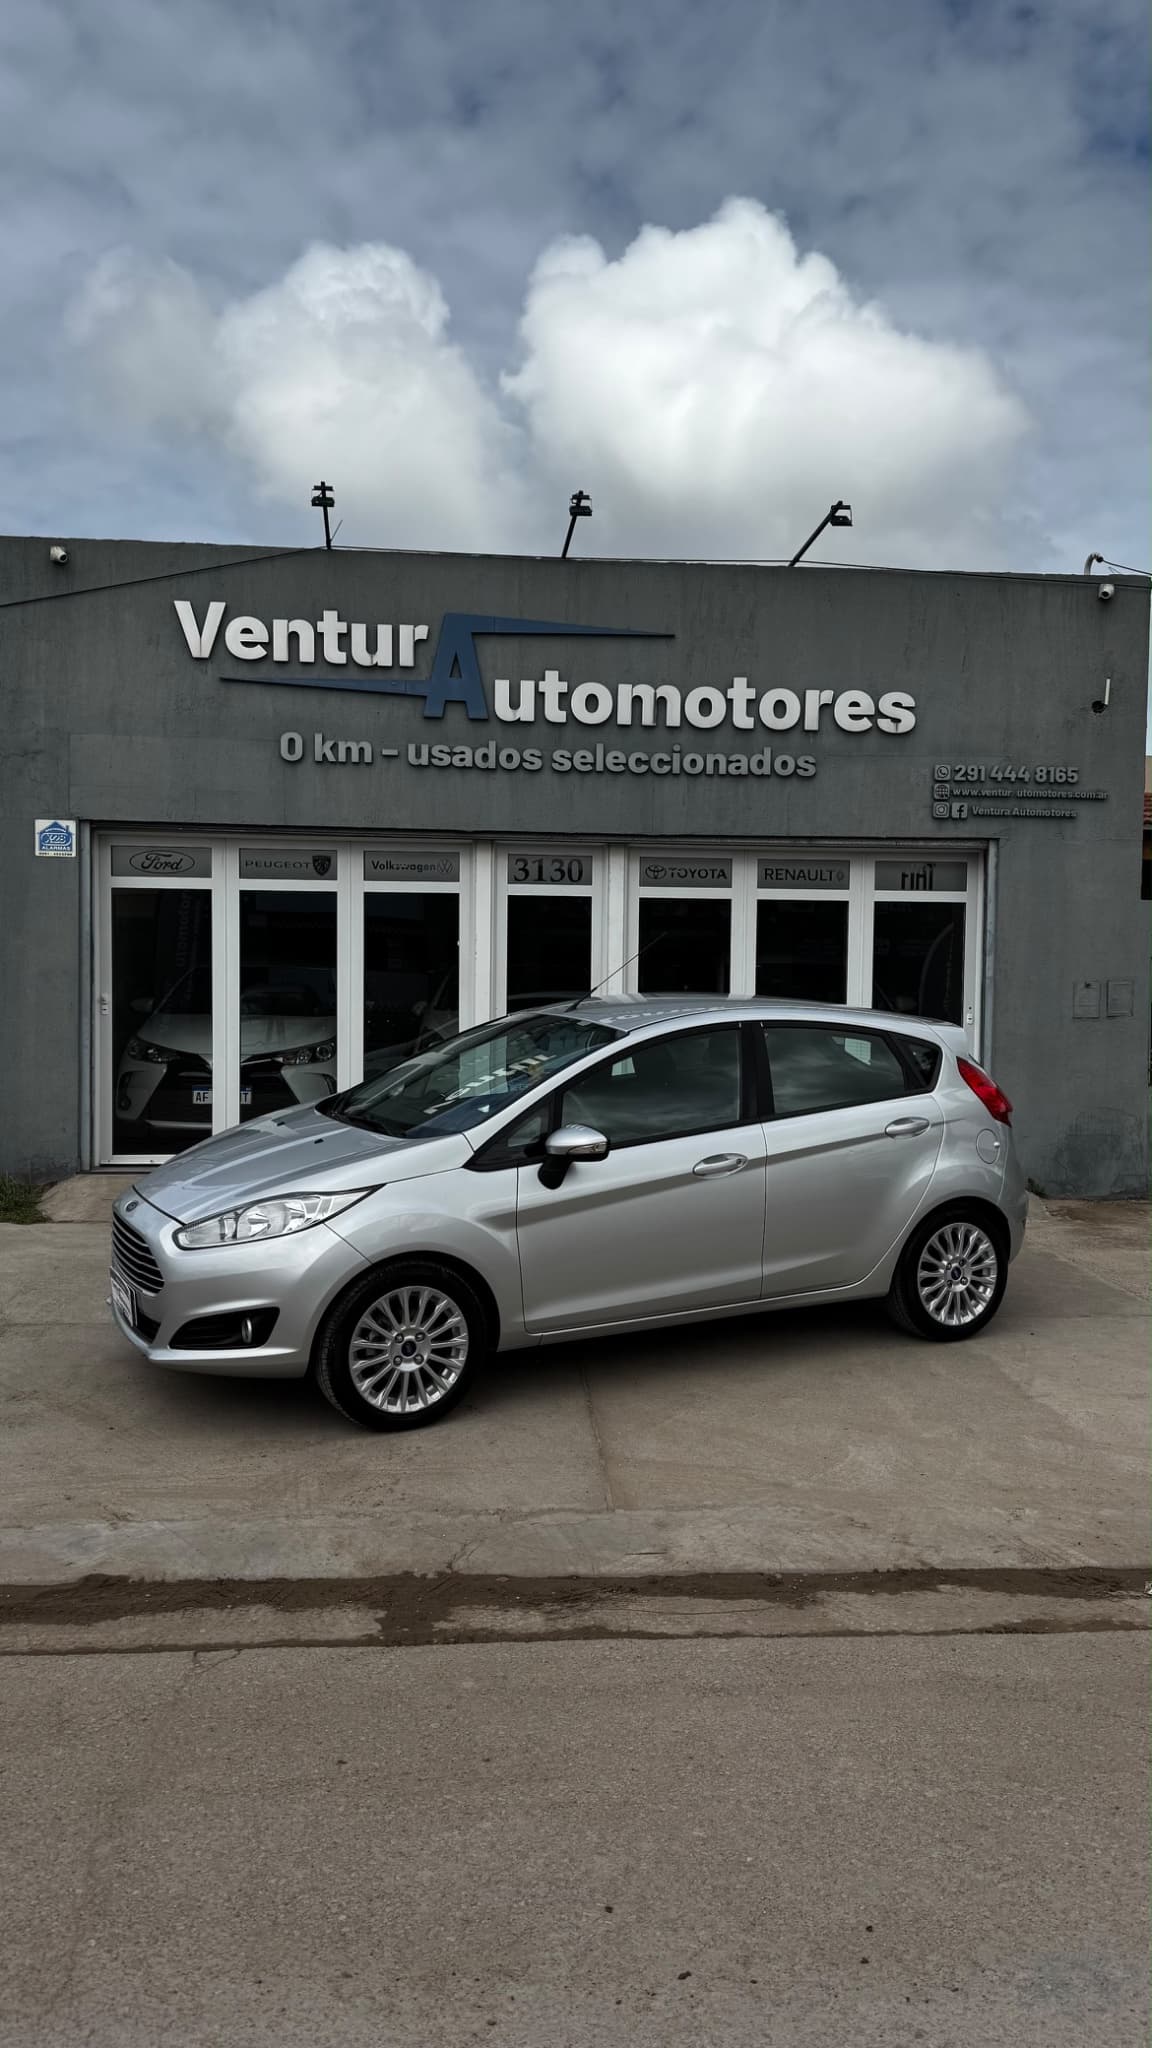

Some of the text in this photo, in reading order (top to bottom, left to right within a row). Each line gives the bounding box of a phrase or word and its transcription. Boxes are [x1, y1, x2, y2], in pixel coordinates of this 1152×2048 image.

[314, 733, 373, 763] km
[408, 740, 543, 771] usados
[551, 743, 817, 776] seleccionados
[953, 764, 1079, 783] 291 444 8165
[972, 805, 1078, 818] Ventura Automotores
[141, 853, 184, 870] Ford
[245, 859, 311, 869] PEUGEOT
[514, 857, 584, 883] 3130
[668, 867, 727, 880] TOYOTA
[764, 867, 836, 882] RENAULT
